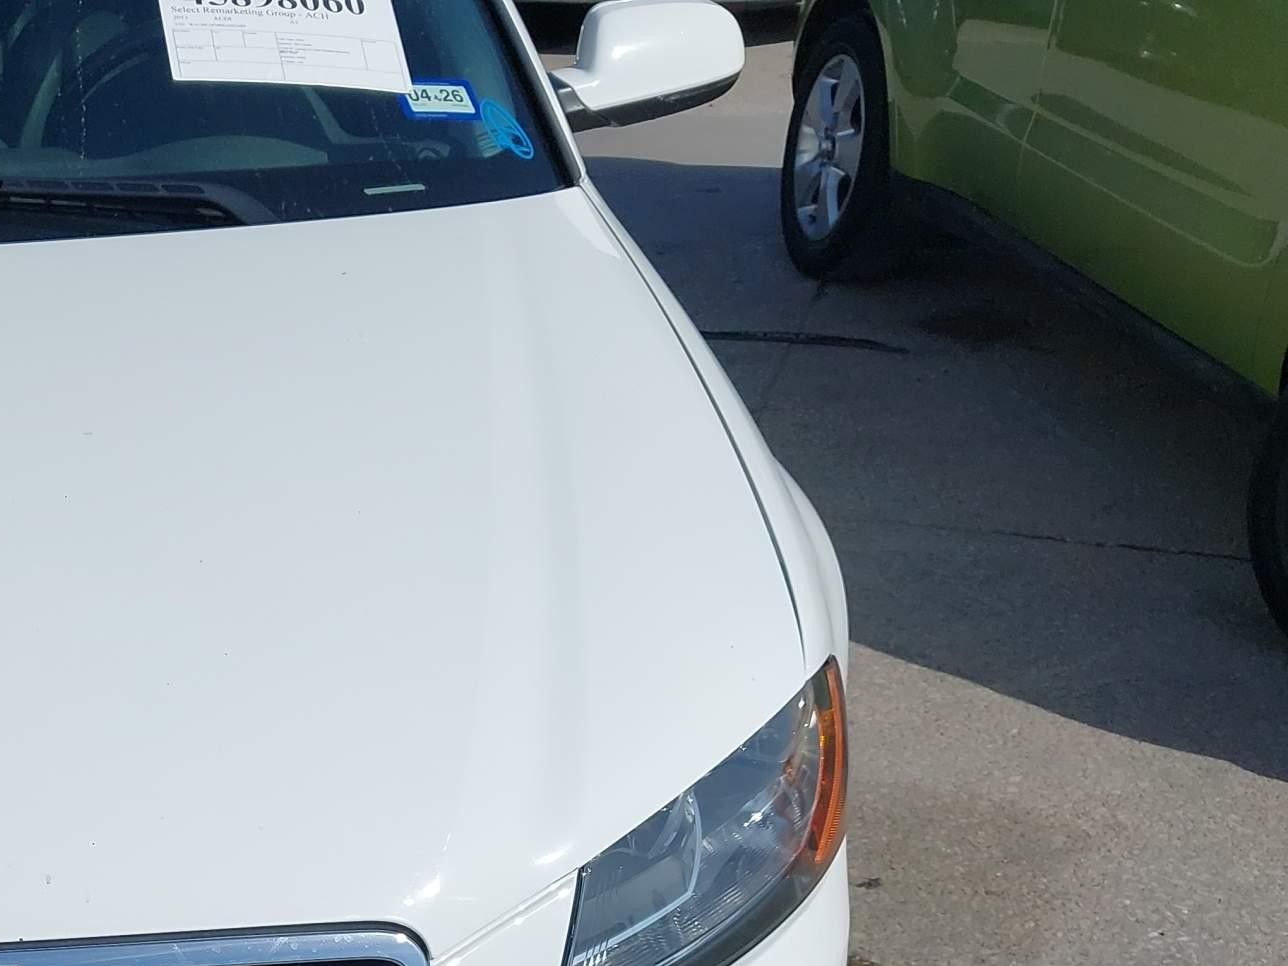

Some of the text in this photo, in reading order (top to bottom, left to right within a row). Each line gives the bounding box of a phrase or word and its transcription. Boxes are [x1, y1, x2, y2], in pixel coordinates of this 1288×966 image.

[171, 6, 200, 14] Select
[203, 7, 264, 17] Remarketing
[266, 9, 296, 18] Group
[440, 88, 463, 102] 26
